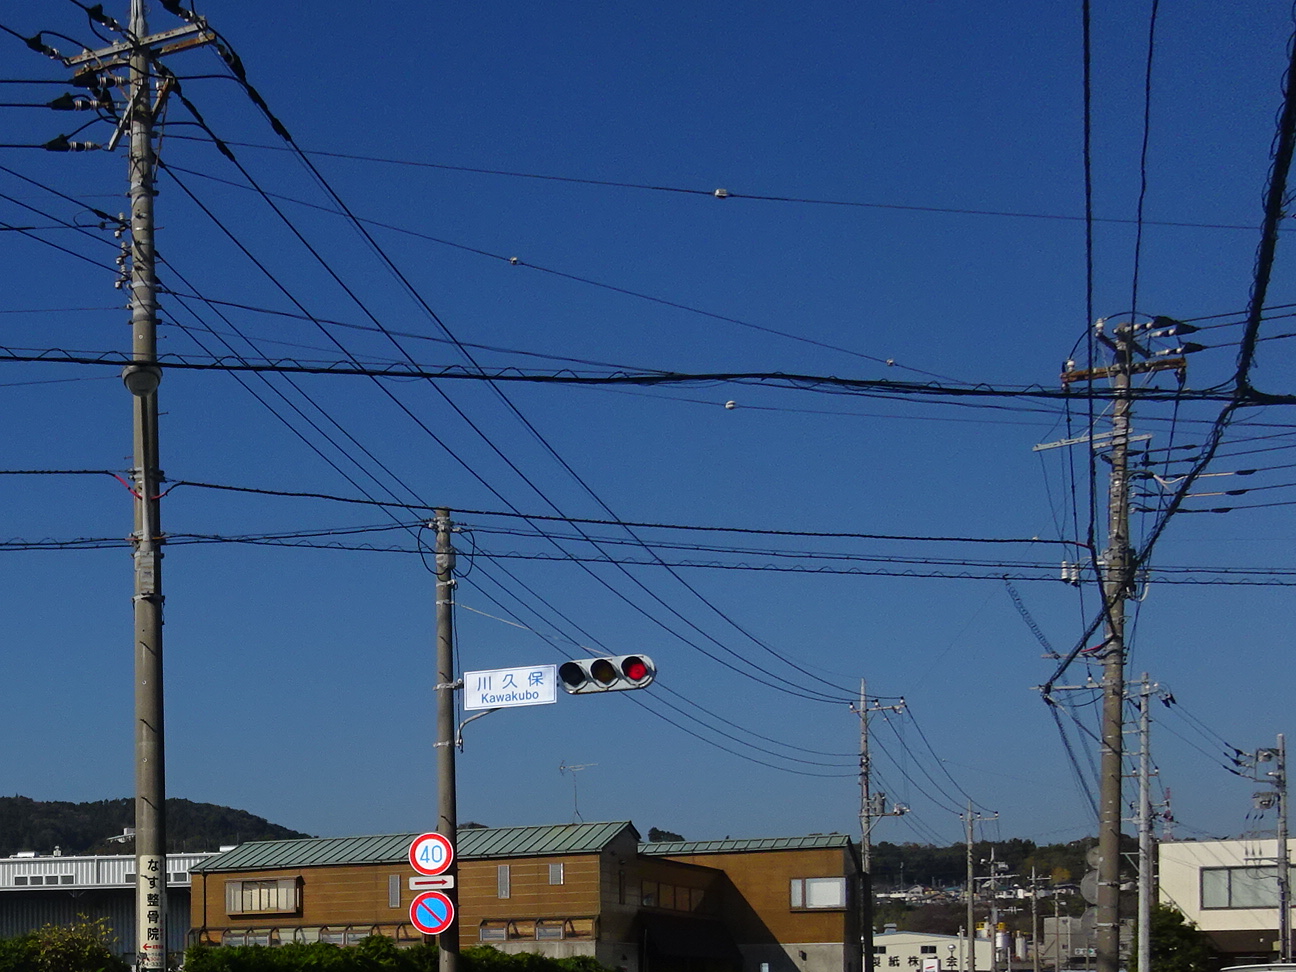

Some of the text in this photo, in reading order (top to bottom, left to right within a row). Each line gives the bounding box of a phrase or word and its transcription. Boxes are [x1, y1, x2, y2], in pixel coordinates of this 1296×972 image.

[477, 671, 544, 691] 川久保
[481, 690, 539, 704] Kawakubo
[420, 845, 442, 863] 40
[147, 859, 159, 940] なす整骨院
[873, 956, 977, 967] 製紙株会
